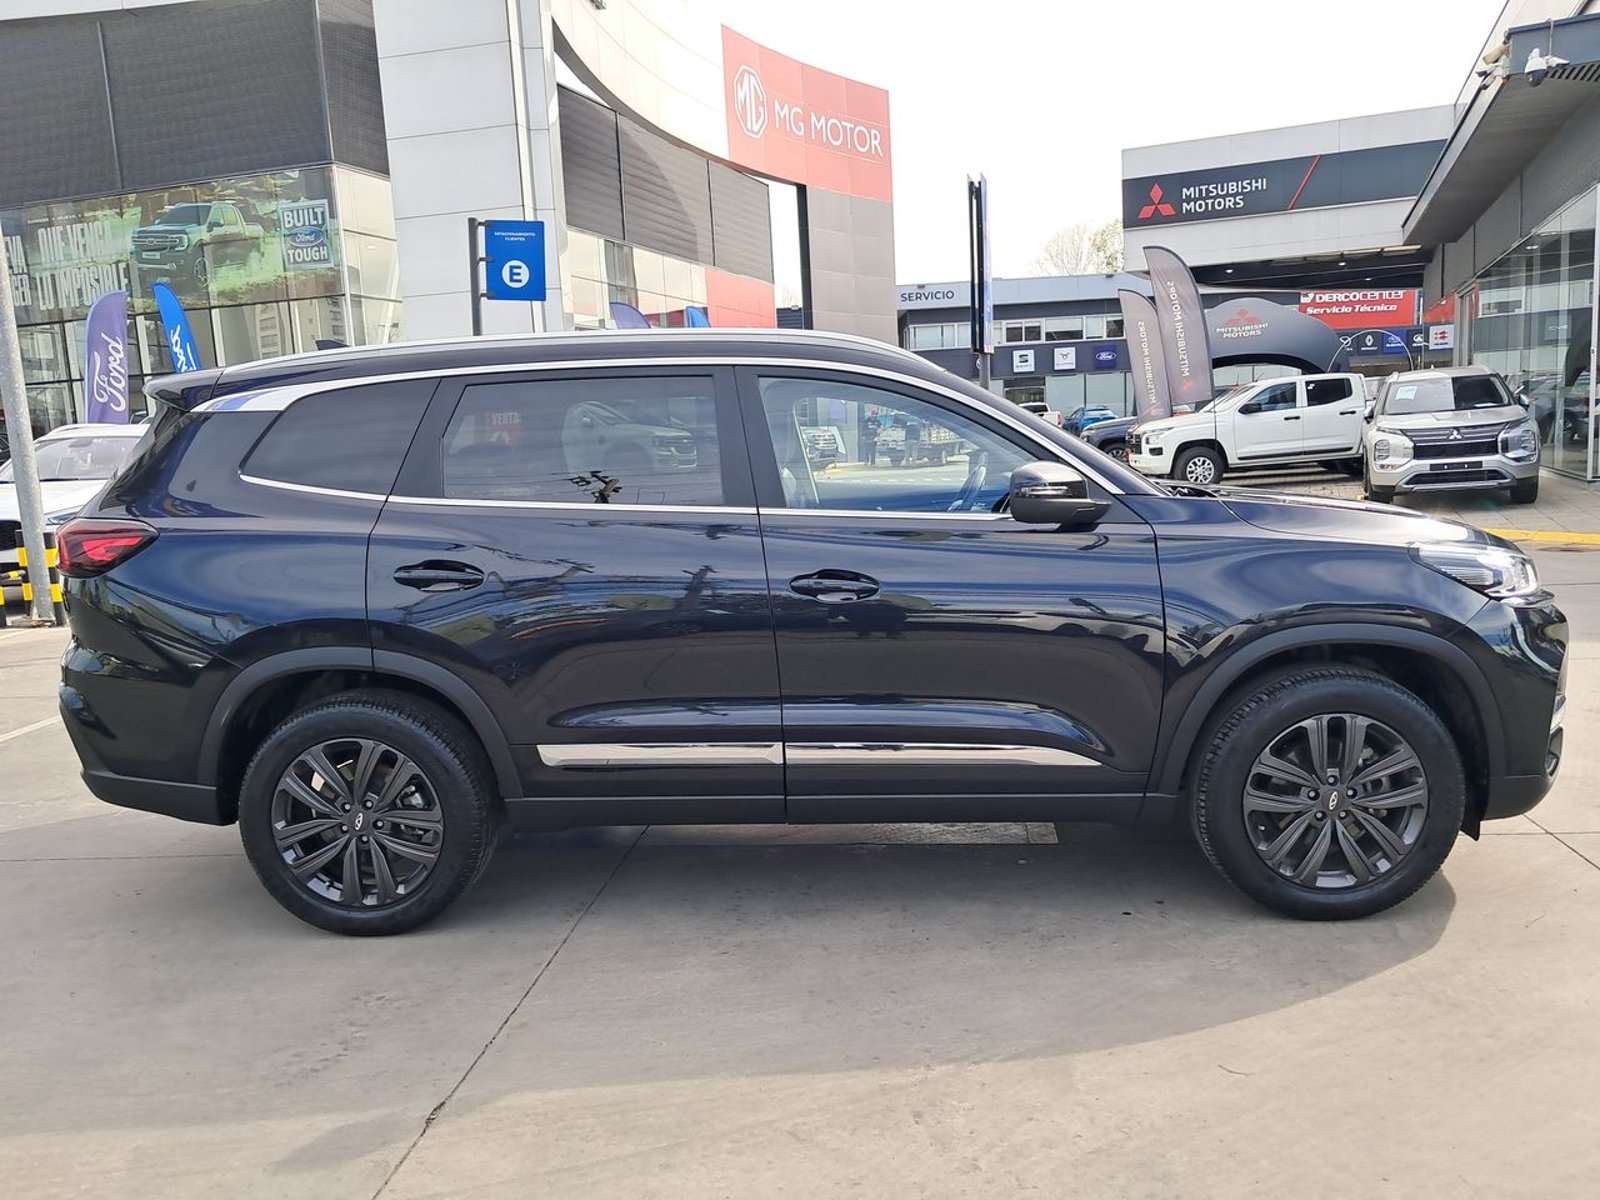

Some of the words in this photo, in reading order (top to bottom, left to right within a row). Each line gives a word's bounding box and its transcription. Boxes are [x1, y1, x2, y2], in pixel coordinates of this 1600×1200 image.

[736, 72, 765, 132] MG
[774, 99, 805, 136] MG
[810, 112, 883, 156] MOTOR
[1182, 177, 1267, 199] MITSUBISHI
[1182, 195, 1244, 214] MOTORS
[284, 207, 324, 228] BUILT
[287, 245, 328, 263] TOUGH
[509, 265, 522, 283] E
[900, 290, 955, 302] SERVICIO
[1306, 304, 1353, 315] Servicio
[1354, 303, 1398, 312] Técnico
[1215, 322, 1269, 334] MITSUBISHI
[1223, 329, 1261, 339] MOTORS
[94, 332, 126, 412] Ford
